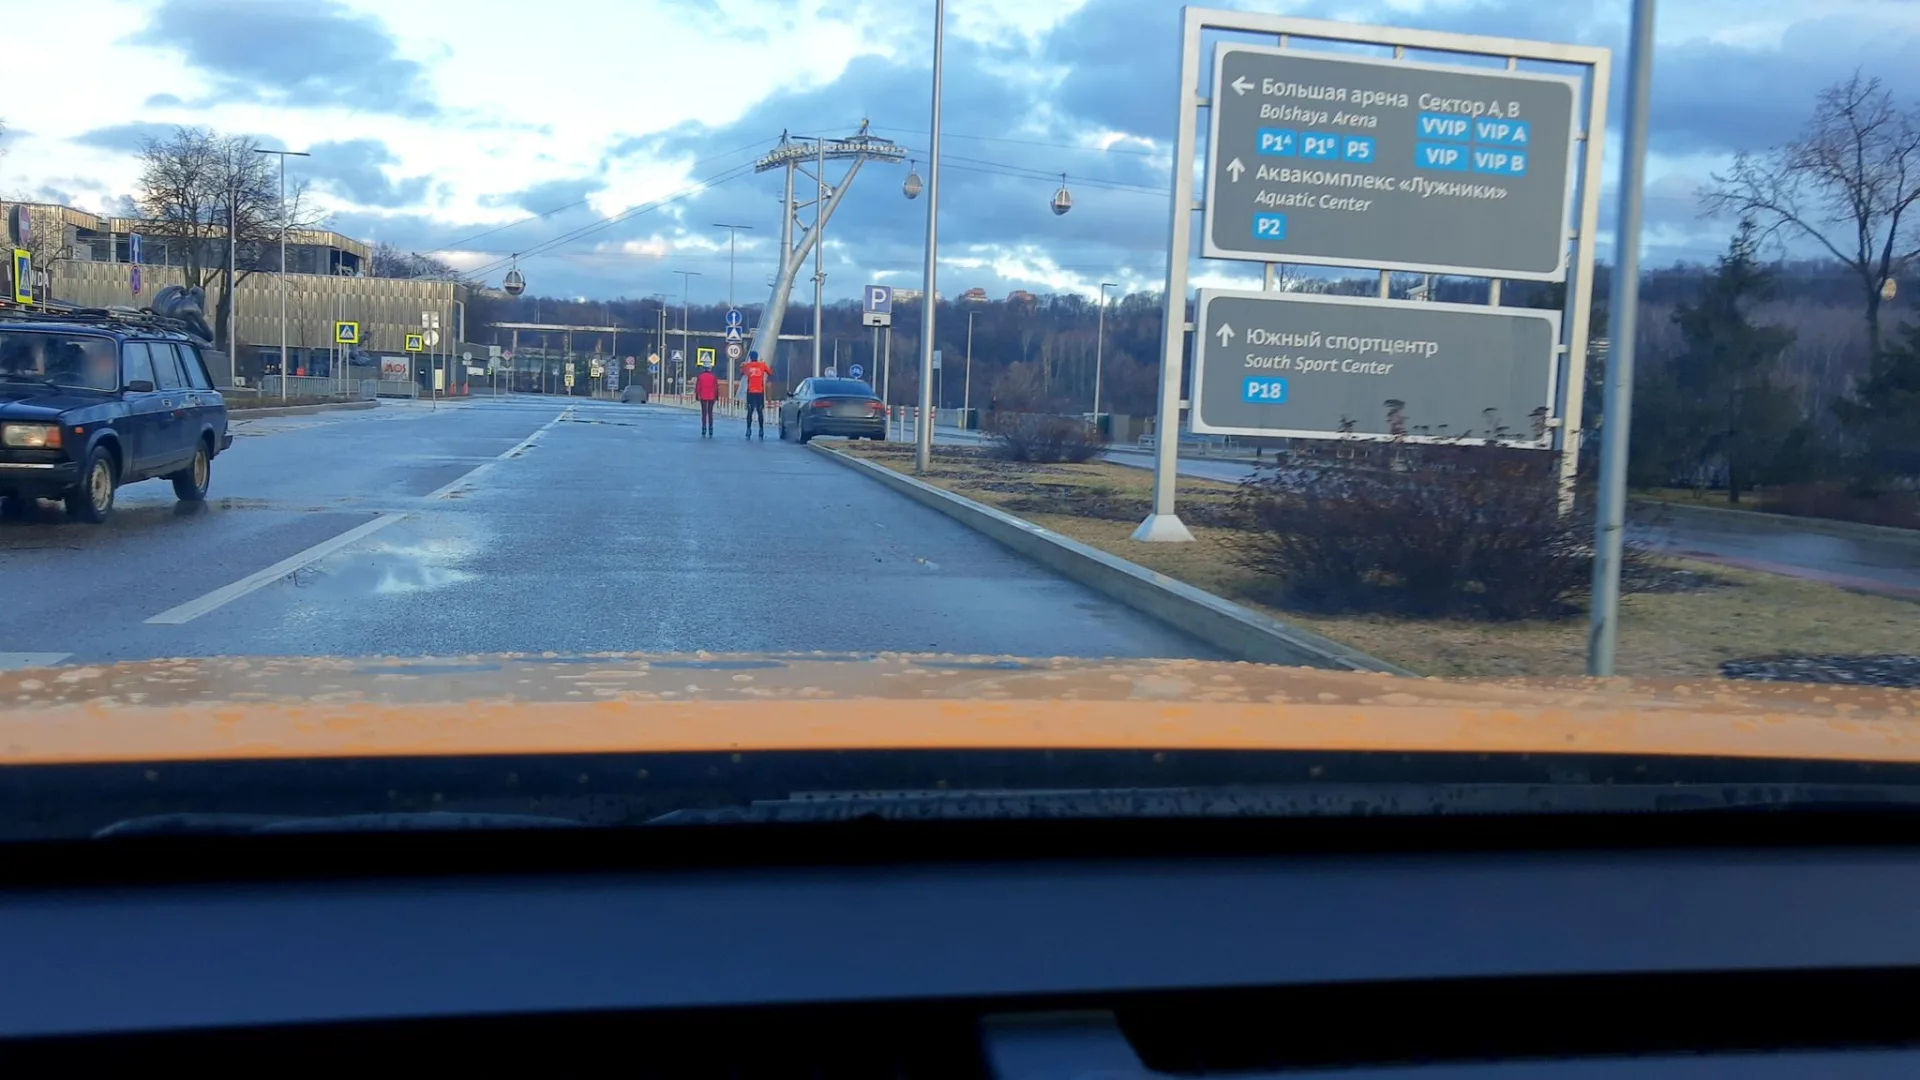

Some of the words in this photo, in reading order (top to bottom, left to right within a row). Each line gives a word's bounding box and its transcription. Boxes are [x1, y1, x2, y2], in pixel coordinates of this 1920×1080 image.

[1262, 78, 1347, 101] Большая
[1351, 89, 1409, 108] арена
[1260, 103, 1328, 126] Bolshaya
[1331, 111, 1378, 128] Arena
[1419, 93, 1486, 118] Сектор
[1421, 117, 1467, 136] VVIP
[1477, 122, 1510, 140] VIP
[1511, 126, 1527, 142] A
[1347, 141, 1369, 158] P5
[1425, 148, 1459, 165] VIP
[1475, 152, 1507, 169] VIP
[1510, 155, 1525, 171] B
[1256, 163, 1395, 191] Аквакомплекс
[1399, 177, 1508, 199] «Лужники»
[1254, 189, 1316, 208] Aquatic
[1318, 194, 1373, 212] Center
[1258, 218, 1281, 235] P2
[871, 288, 887, 310] P
[1246, 328, 1322, 348] Южный
[1325, 335, 1439, 359] спортцентр
[1244, 353, 1291, 370] South
[1295, 356, 1339, 374] Sport
[1341, 359, 1394, 375] Center
[1247, 381, 1282, 399] P18
